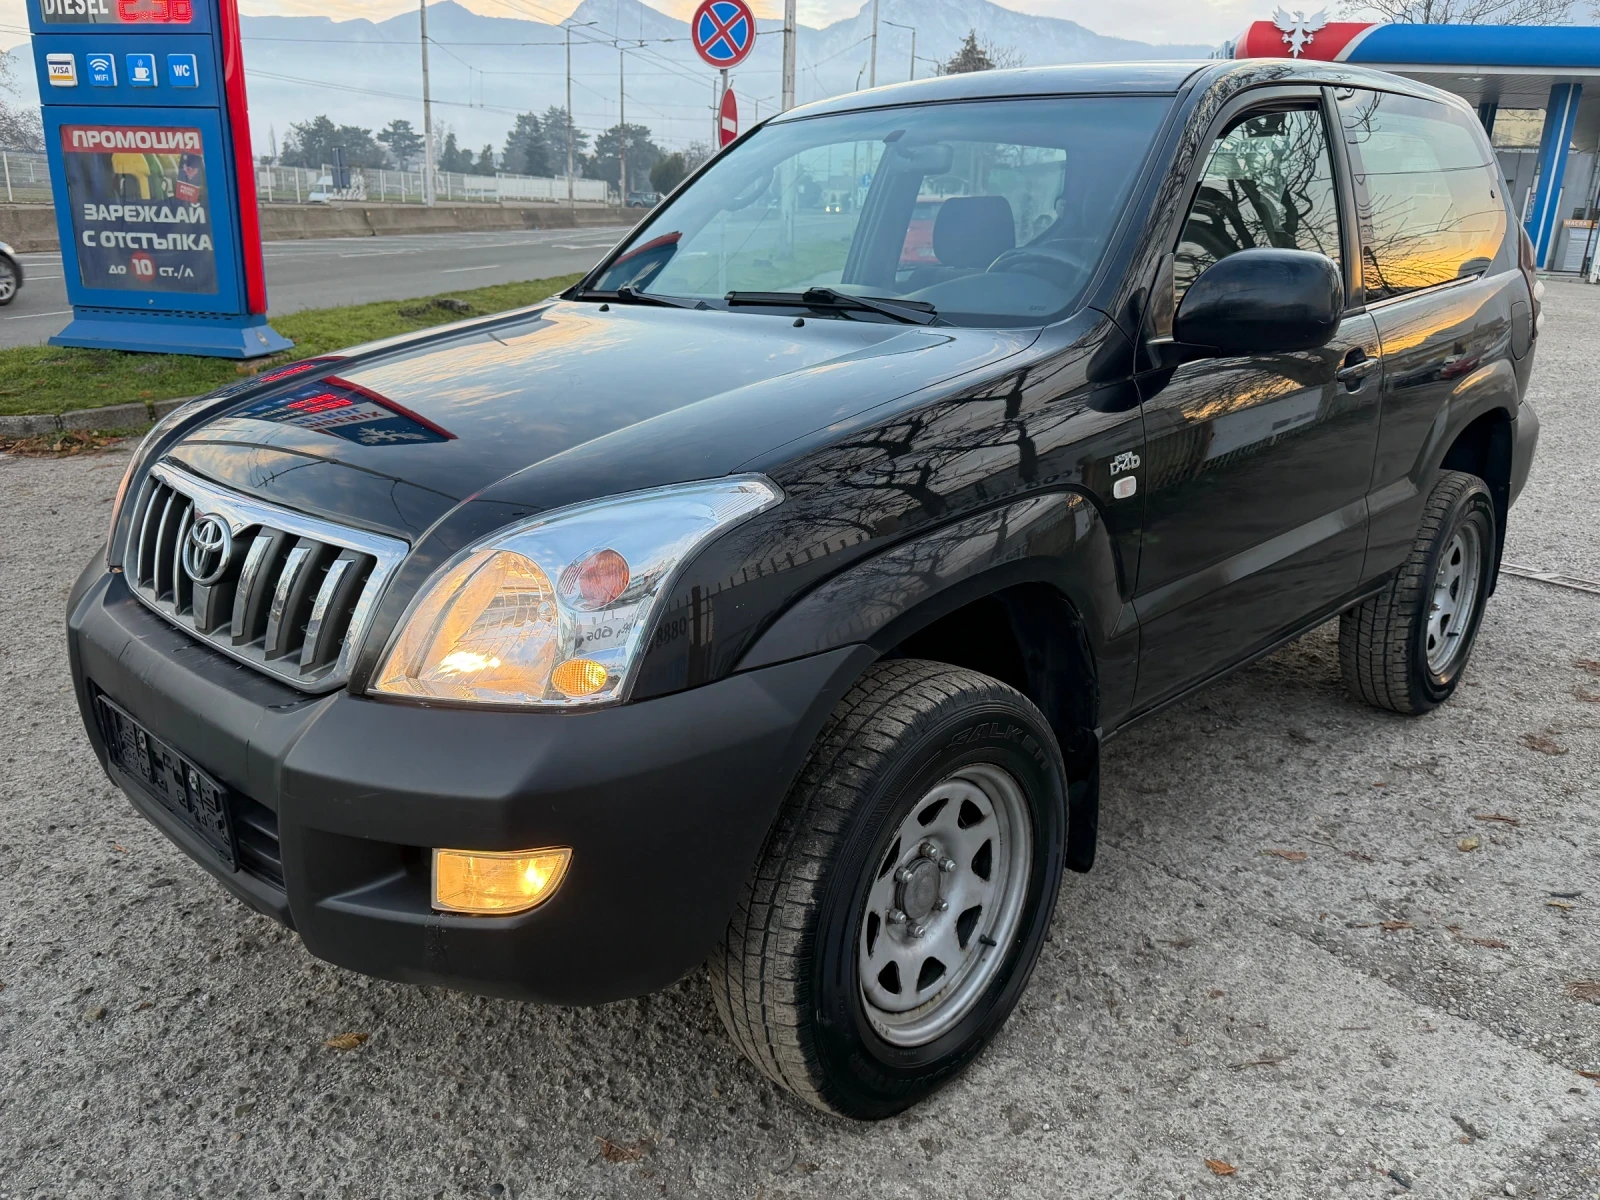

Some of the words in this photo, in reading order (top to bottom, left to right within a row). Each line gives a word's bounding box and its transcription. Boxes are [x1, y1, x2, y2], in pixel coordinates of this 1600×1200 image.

[44, 0, 109, 15] DIESEL
[52, 66, 69, 74] VISA
[173, 64, 190, 77] WC
[72, 130, 200, 149] ПРОМОЦИЯ
[83, 203, 206, 223] ЗАРЕЖДАЙ
[82, 230, 97, 247] С
[100, 231, 213, 251] ОТСТЪПКА
[131, 258, 153, 275] 10
[1109, 454, 1140, 476] D-4D
